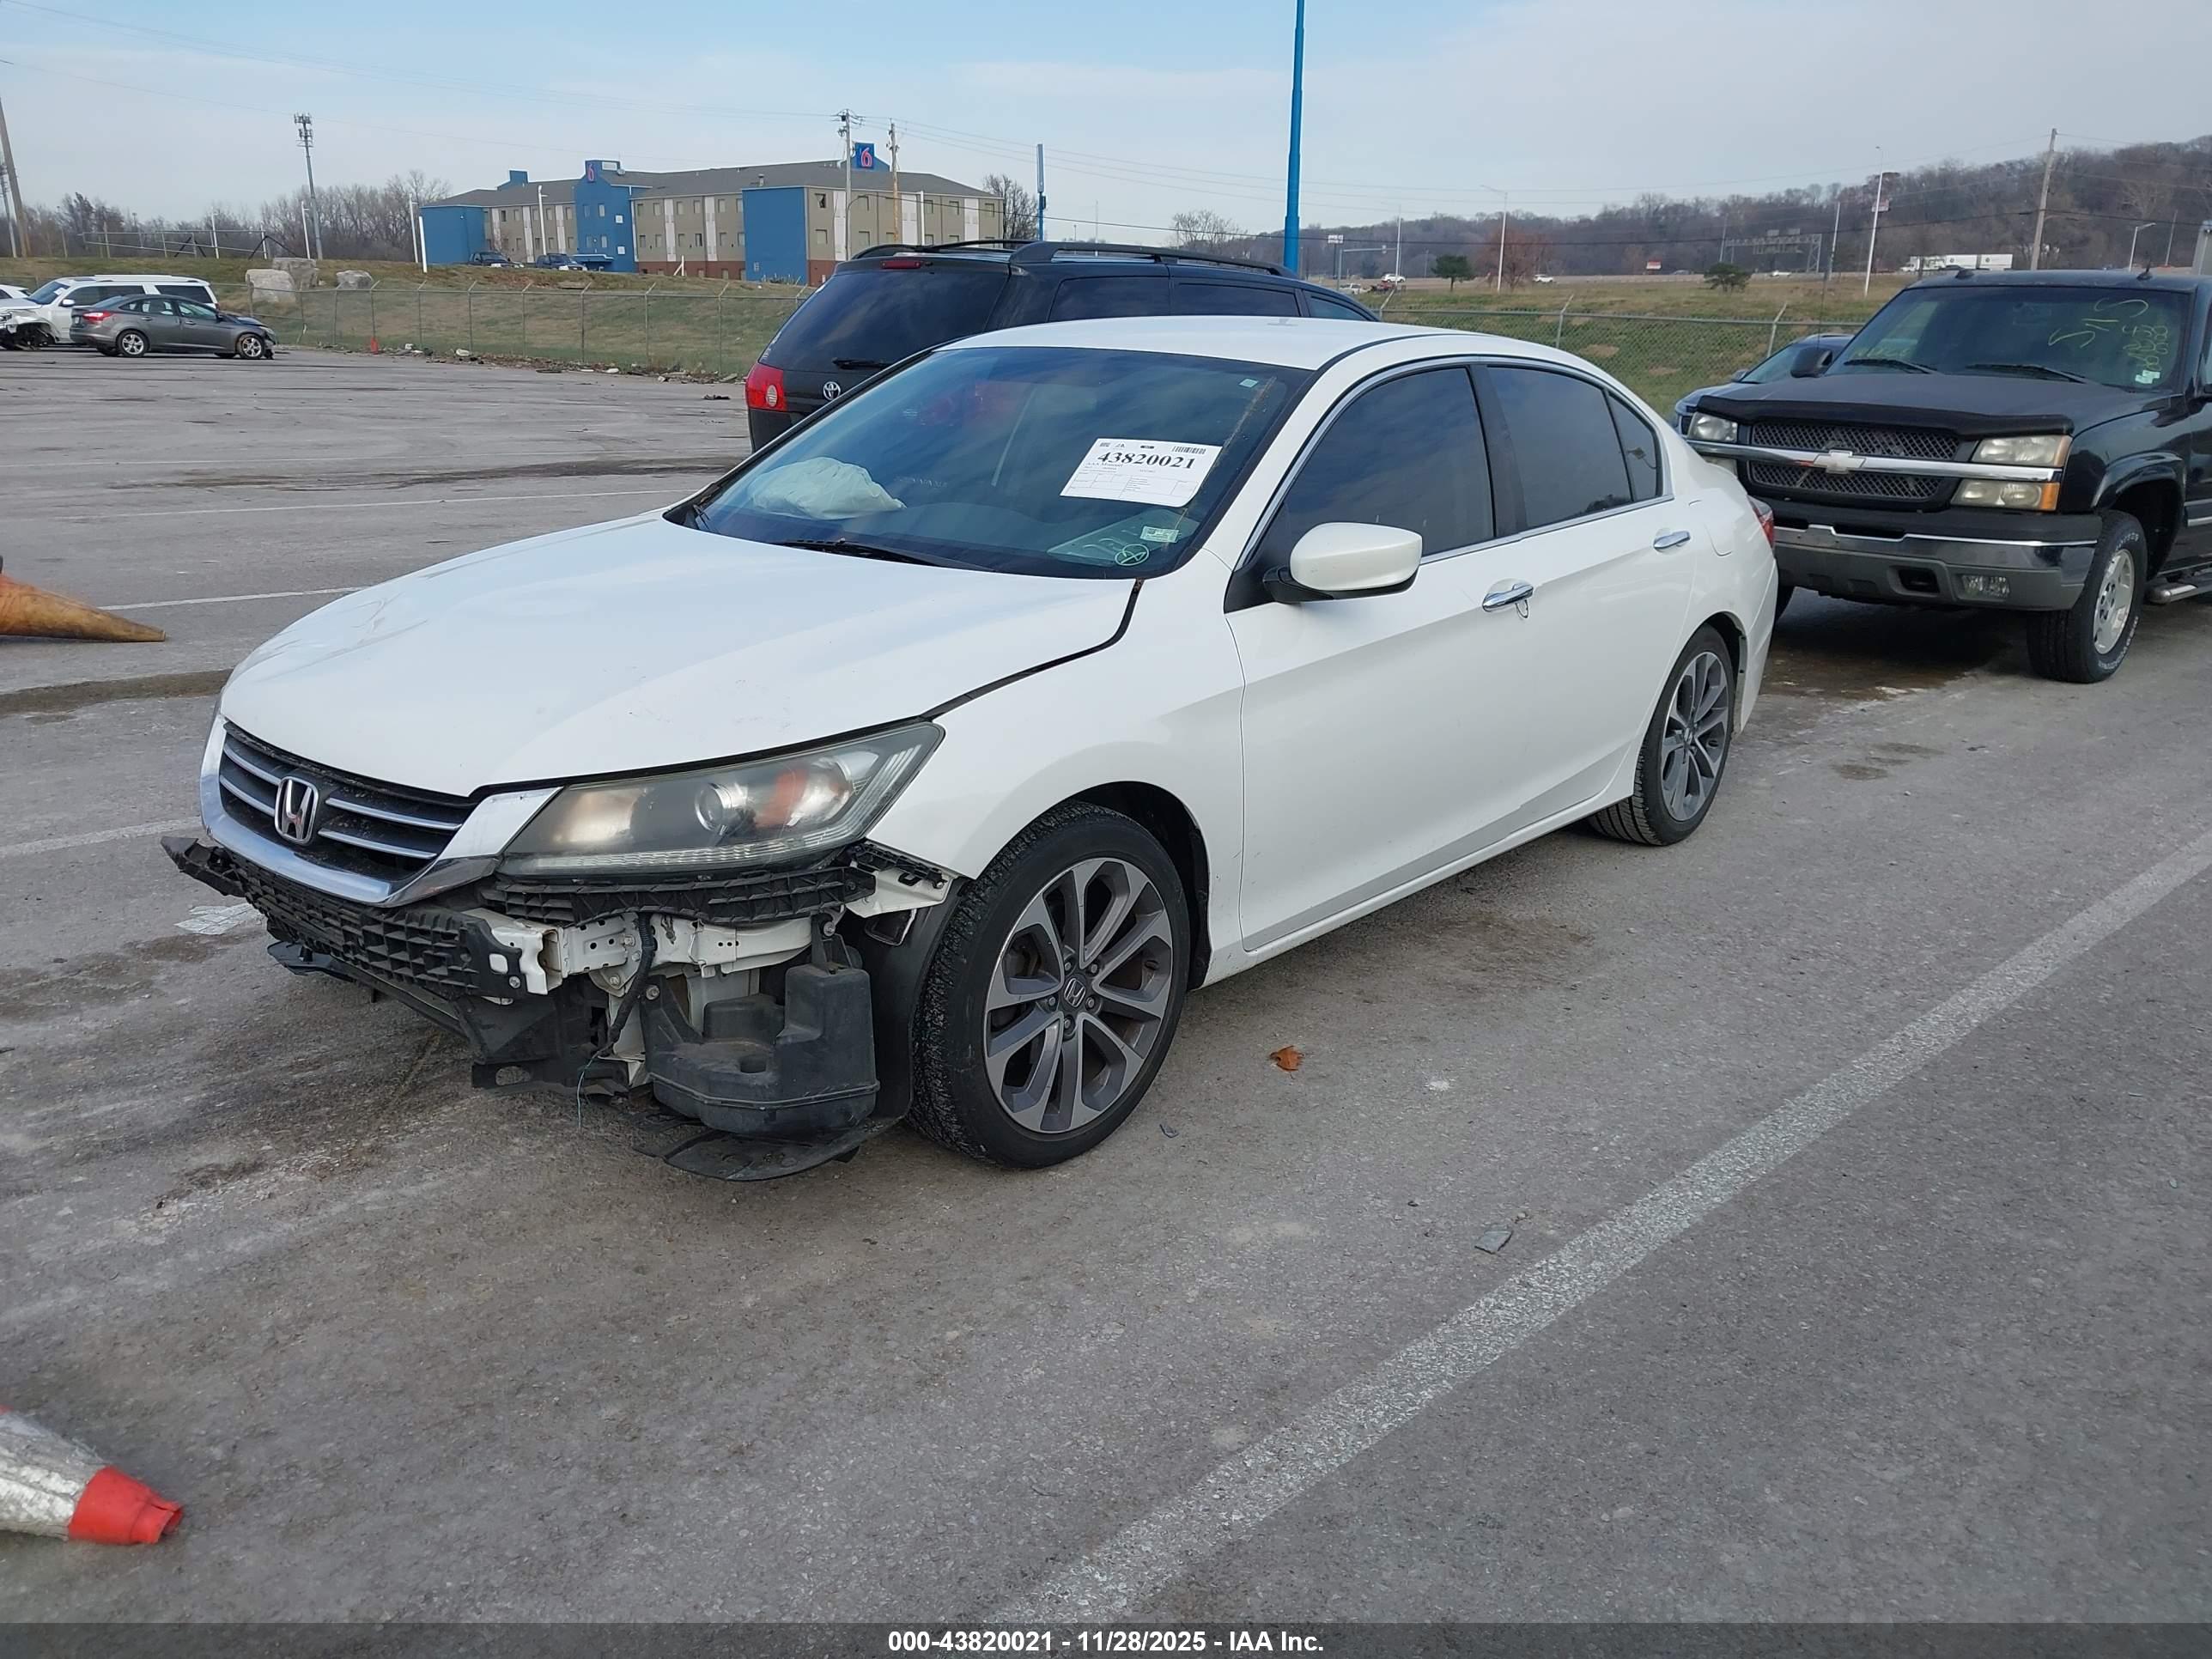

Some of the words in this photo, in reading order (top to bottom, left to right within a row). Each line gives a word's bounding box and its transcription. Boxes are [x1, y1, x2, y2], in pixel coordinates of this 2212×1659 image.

[860, 147, 872, 167] 6
[586, 163, 595, 182] 6
[1097, 452, 1195, 469] 43820021
